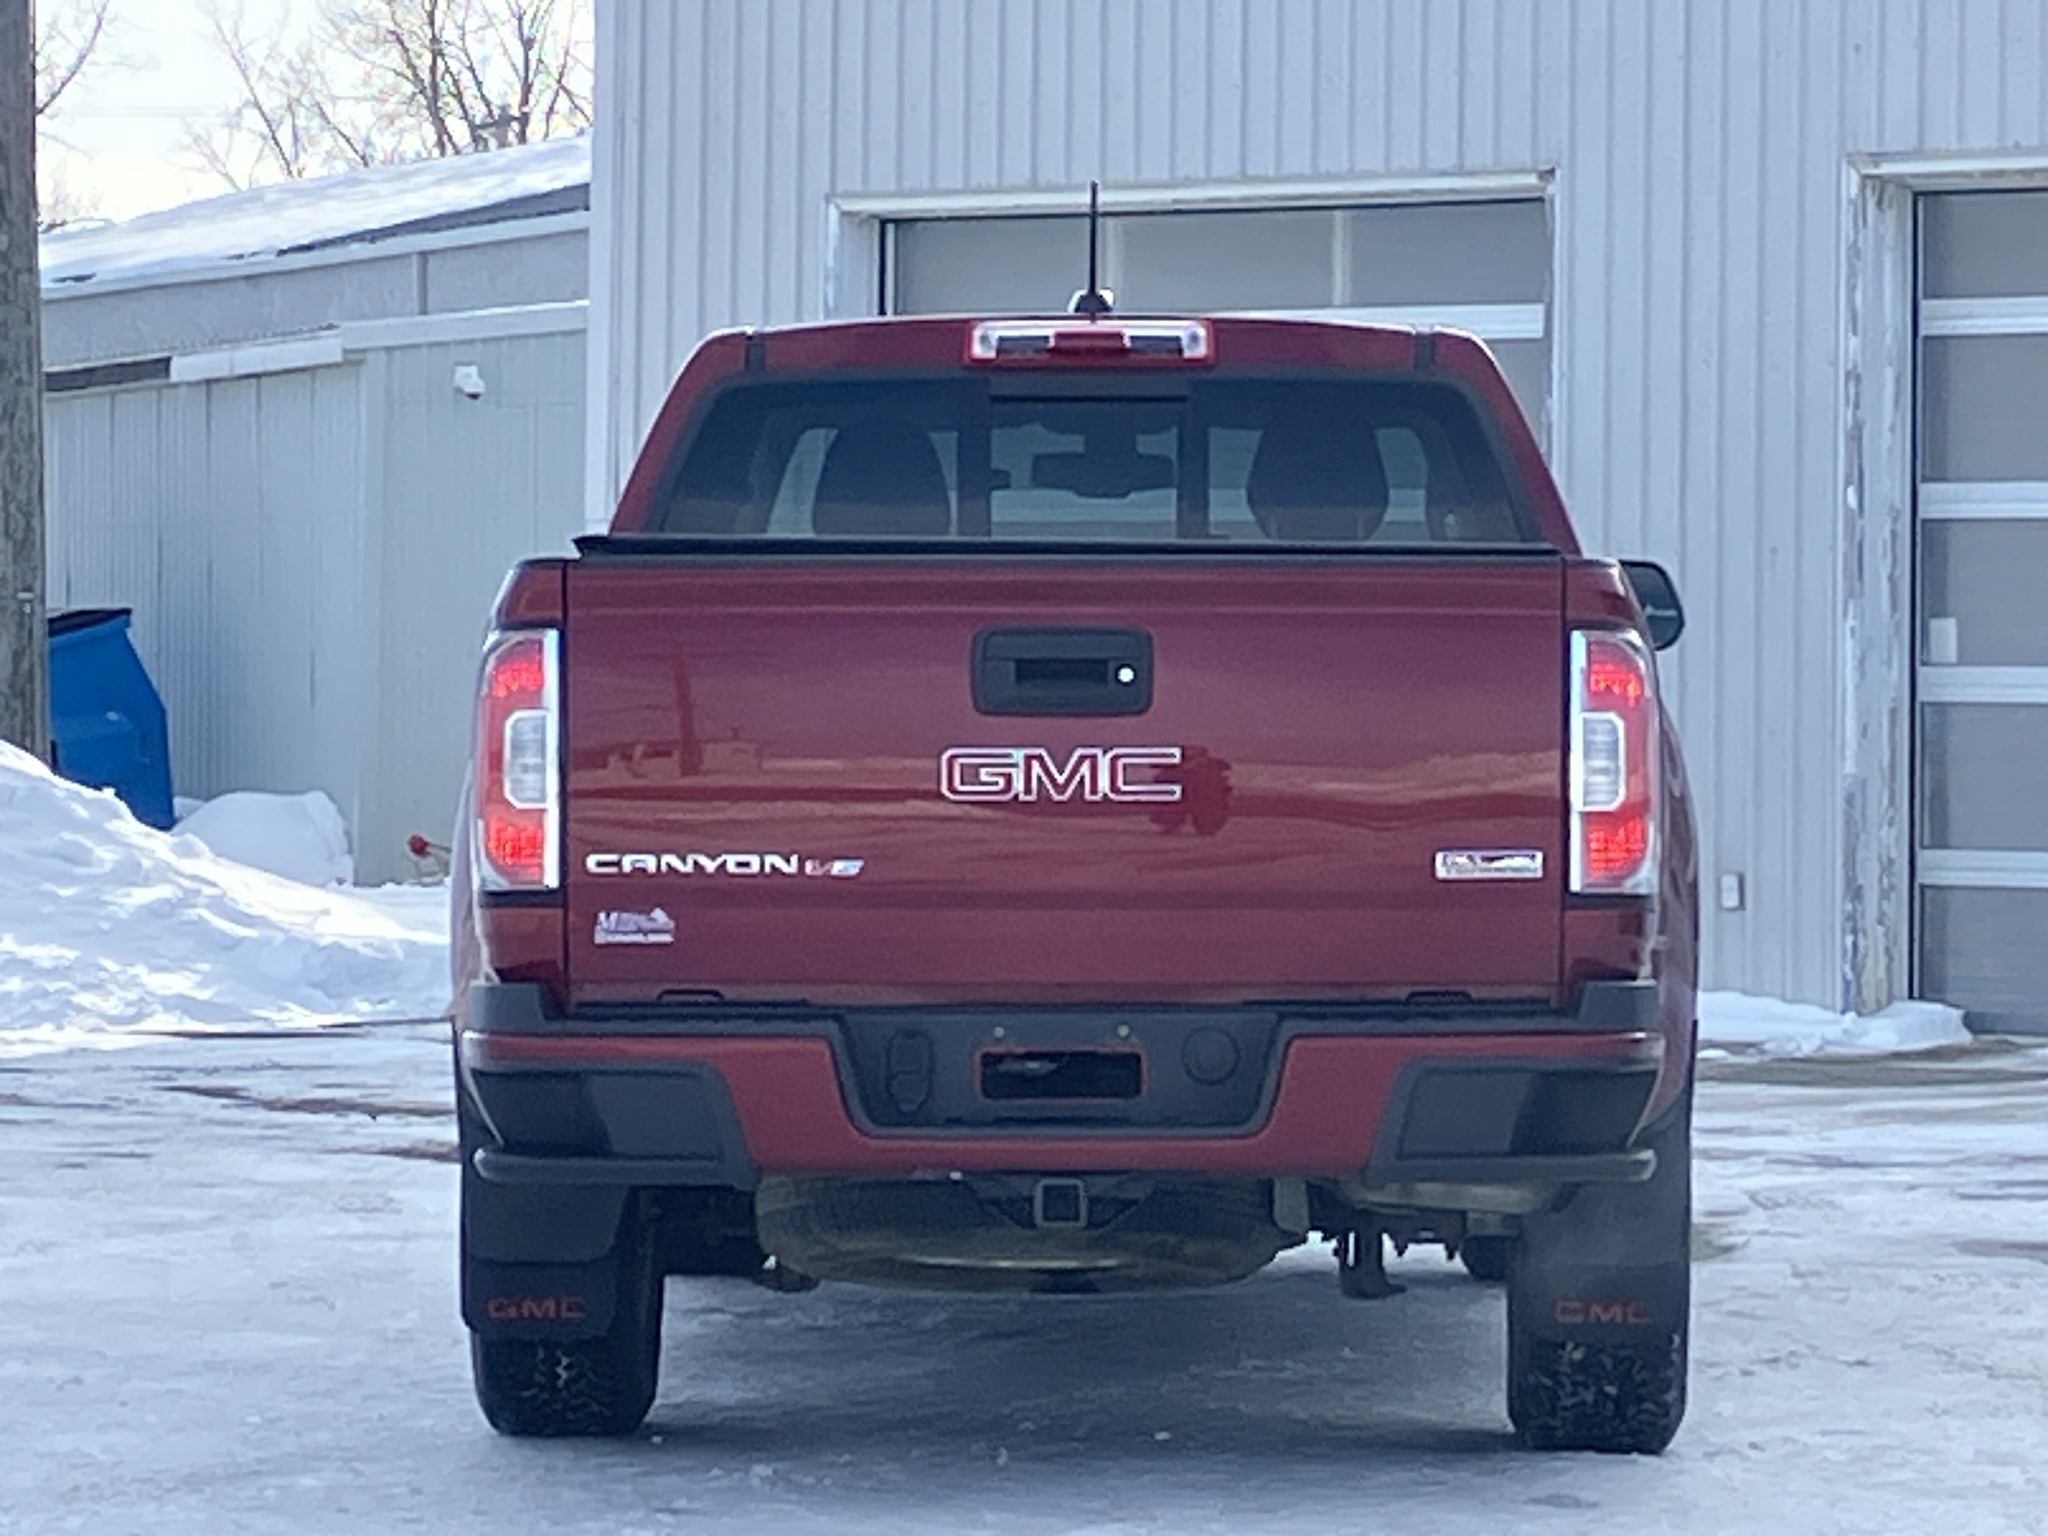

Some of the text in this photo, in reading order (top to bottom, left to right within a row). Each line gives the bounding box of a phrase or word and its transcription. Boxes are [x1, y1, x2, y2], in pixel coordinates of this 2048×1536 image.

[940, 747, 1183, 802] GMC
[586, 853, 799, 875] CANYON
[487, 1296, 586, 1319] GMC
[1555, 1299, 1653, 1323] GMC
